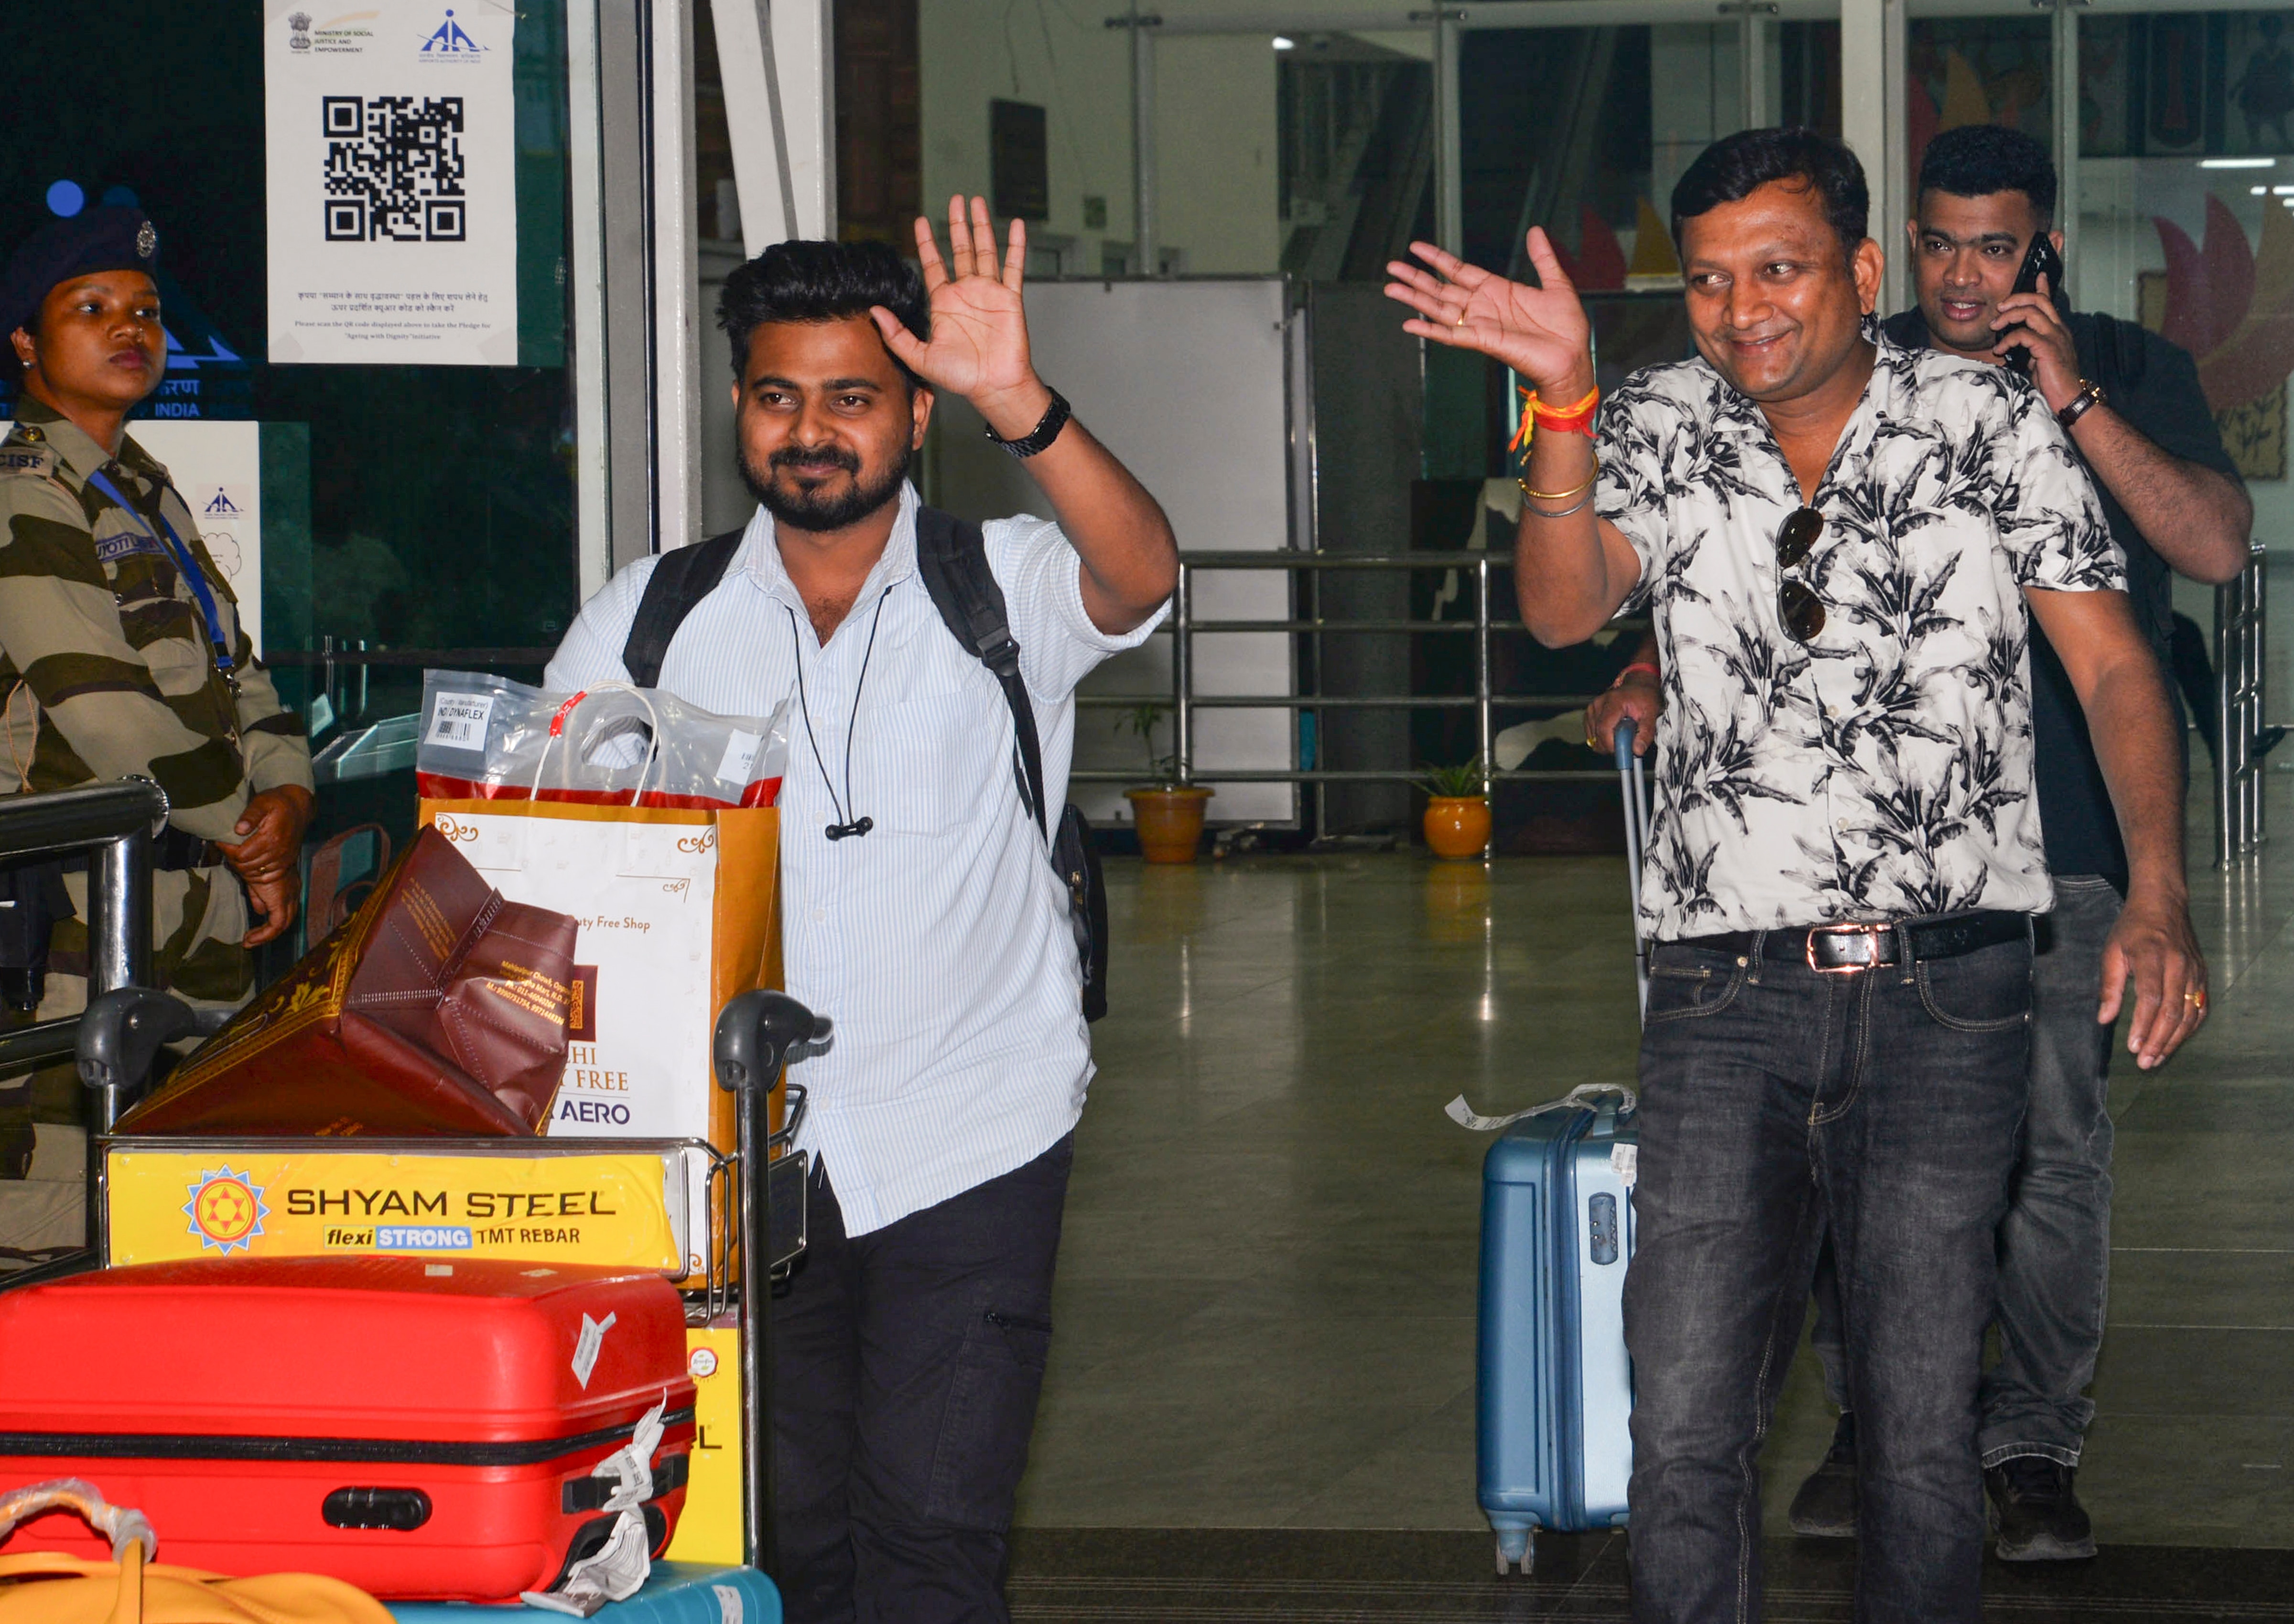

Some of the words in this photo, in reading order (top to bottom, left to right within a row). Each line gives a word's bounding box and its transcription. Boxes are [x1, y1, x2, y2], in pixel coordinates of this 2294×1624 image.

[155, 402, 201, 417] INDIA
[597, 916, 620, 928] Free
[623, 917, 650, 934] Shop
[575, 1069, 628, 1091] FREE
[561, 1100, 630, 1125] AERO
[287, 1189, 447, 1216] SHYAM
[466, 1191, 617, 1218] STEEL
[326, 1228, 374, 1247] flexi
[379, 1228, 469, 1247] STRONG
[476, 1229, 516, 1244] TMT
[520, 1227, 581, 1244] REBAR
